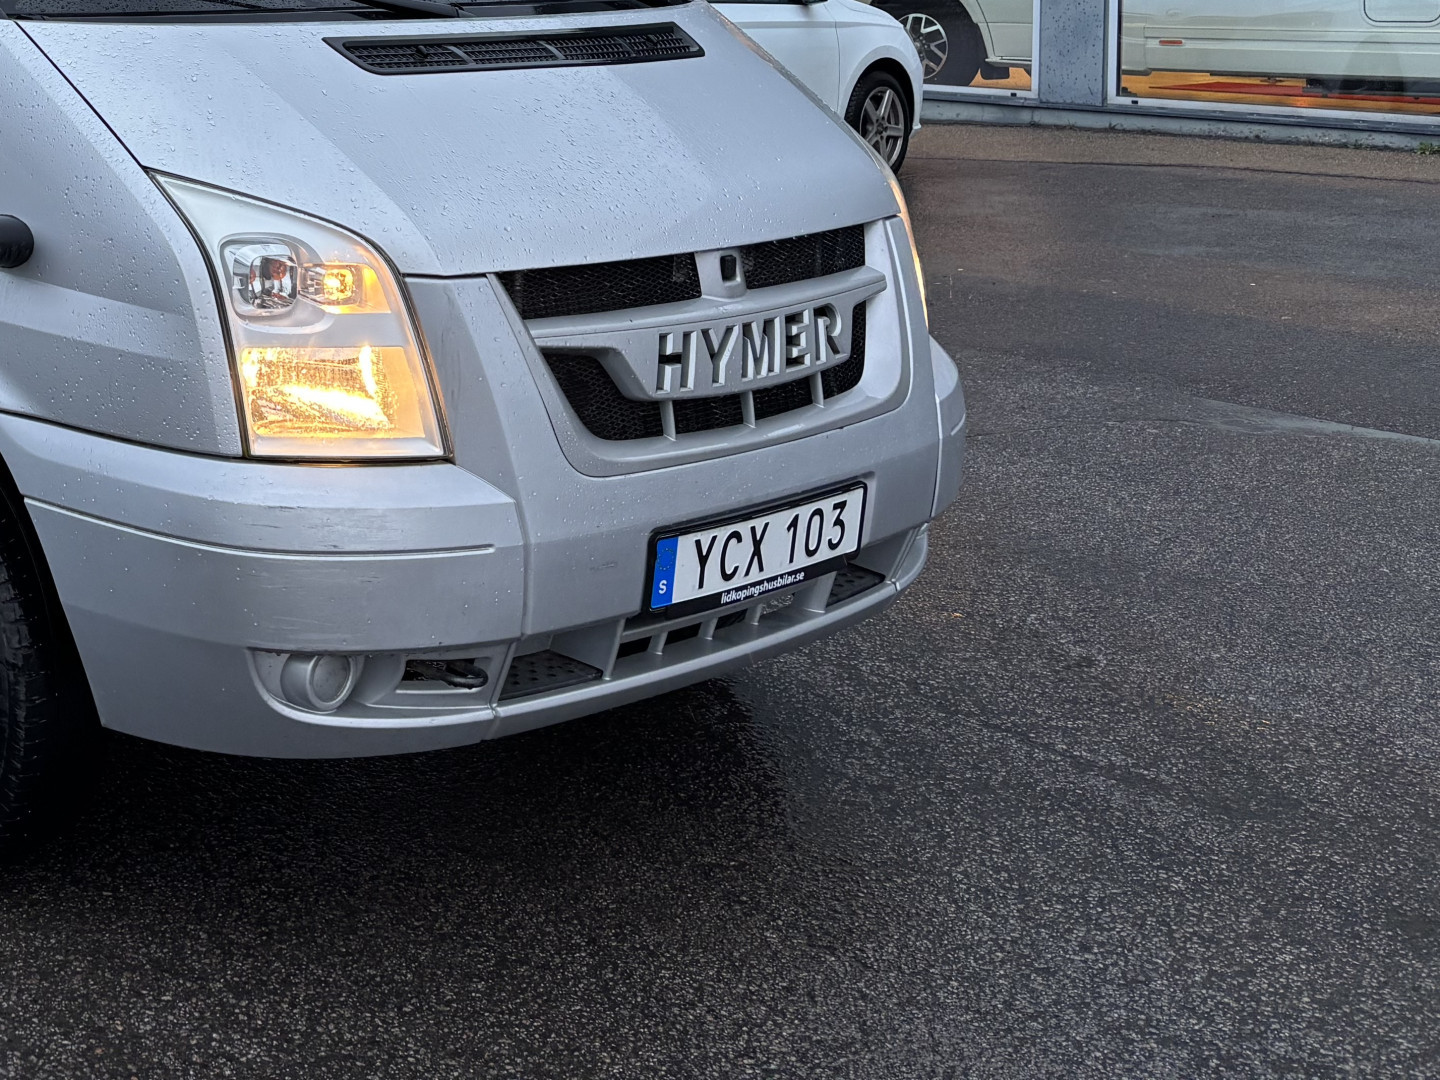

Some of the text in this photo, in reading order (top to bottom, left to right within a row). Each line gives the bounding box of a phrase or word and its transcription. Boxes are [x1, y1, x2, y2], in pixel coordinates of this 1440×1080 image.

[655, 302, 846, 395] HYMER
[694, 499, 848, 590] YCX 103
[658, 580, 668, 594] S
[720, 571, 805, 605] lidkopingshusbilar.se
